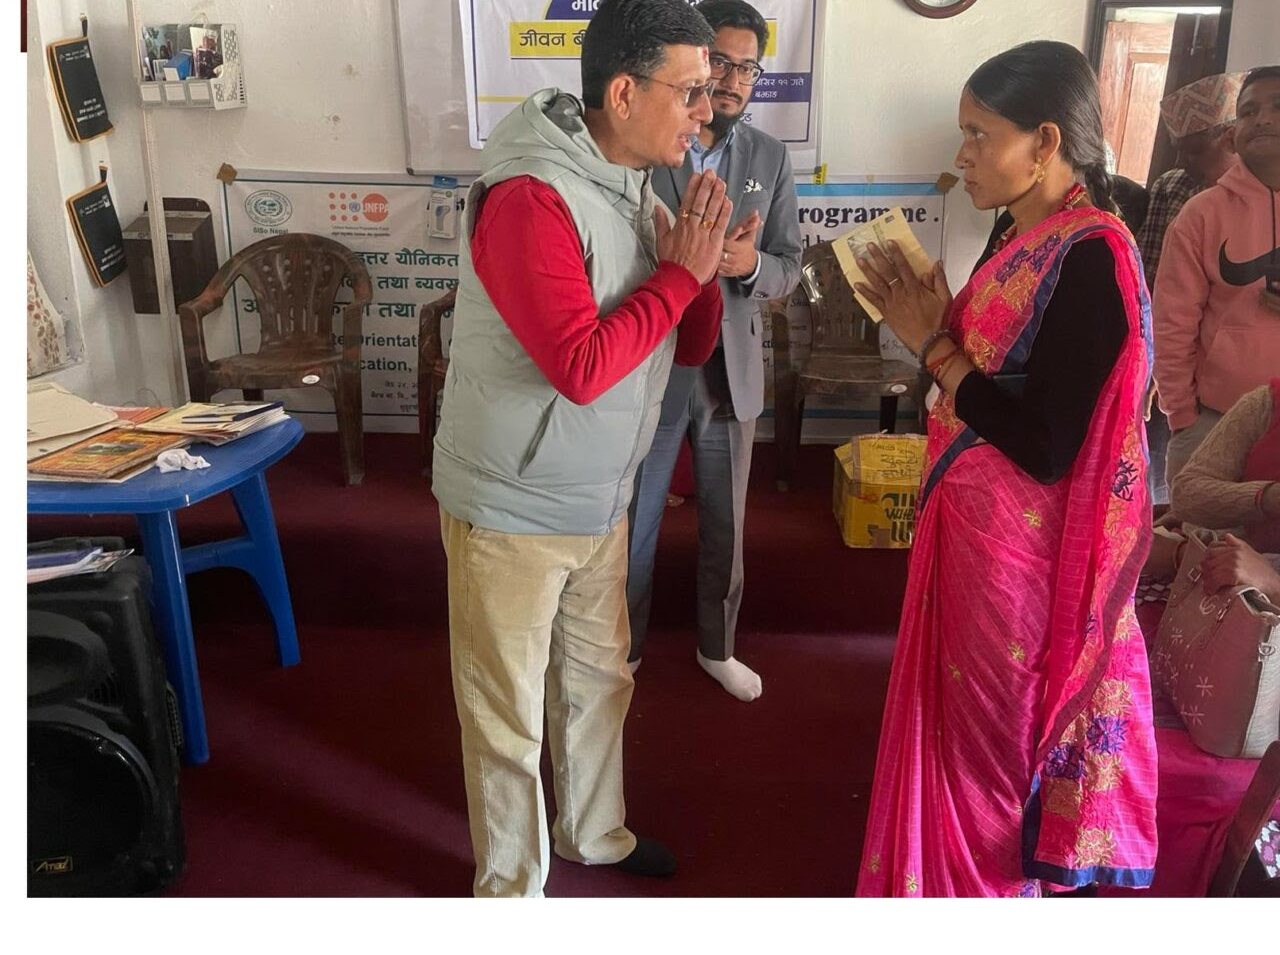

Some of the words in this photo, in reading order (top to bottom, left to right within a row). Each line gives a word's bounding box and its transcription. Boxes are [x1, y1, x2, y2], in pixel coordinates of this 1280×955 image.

[519, 29, 566, 47] जीवन
[377, 276, 410, 290] तथा
[378, 302, 416, 318] तथा
